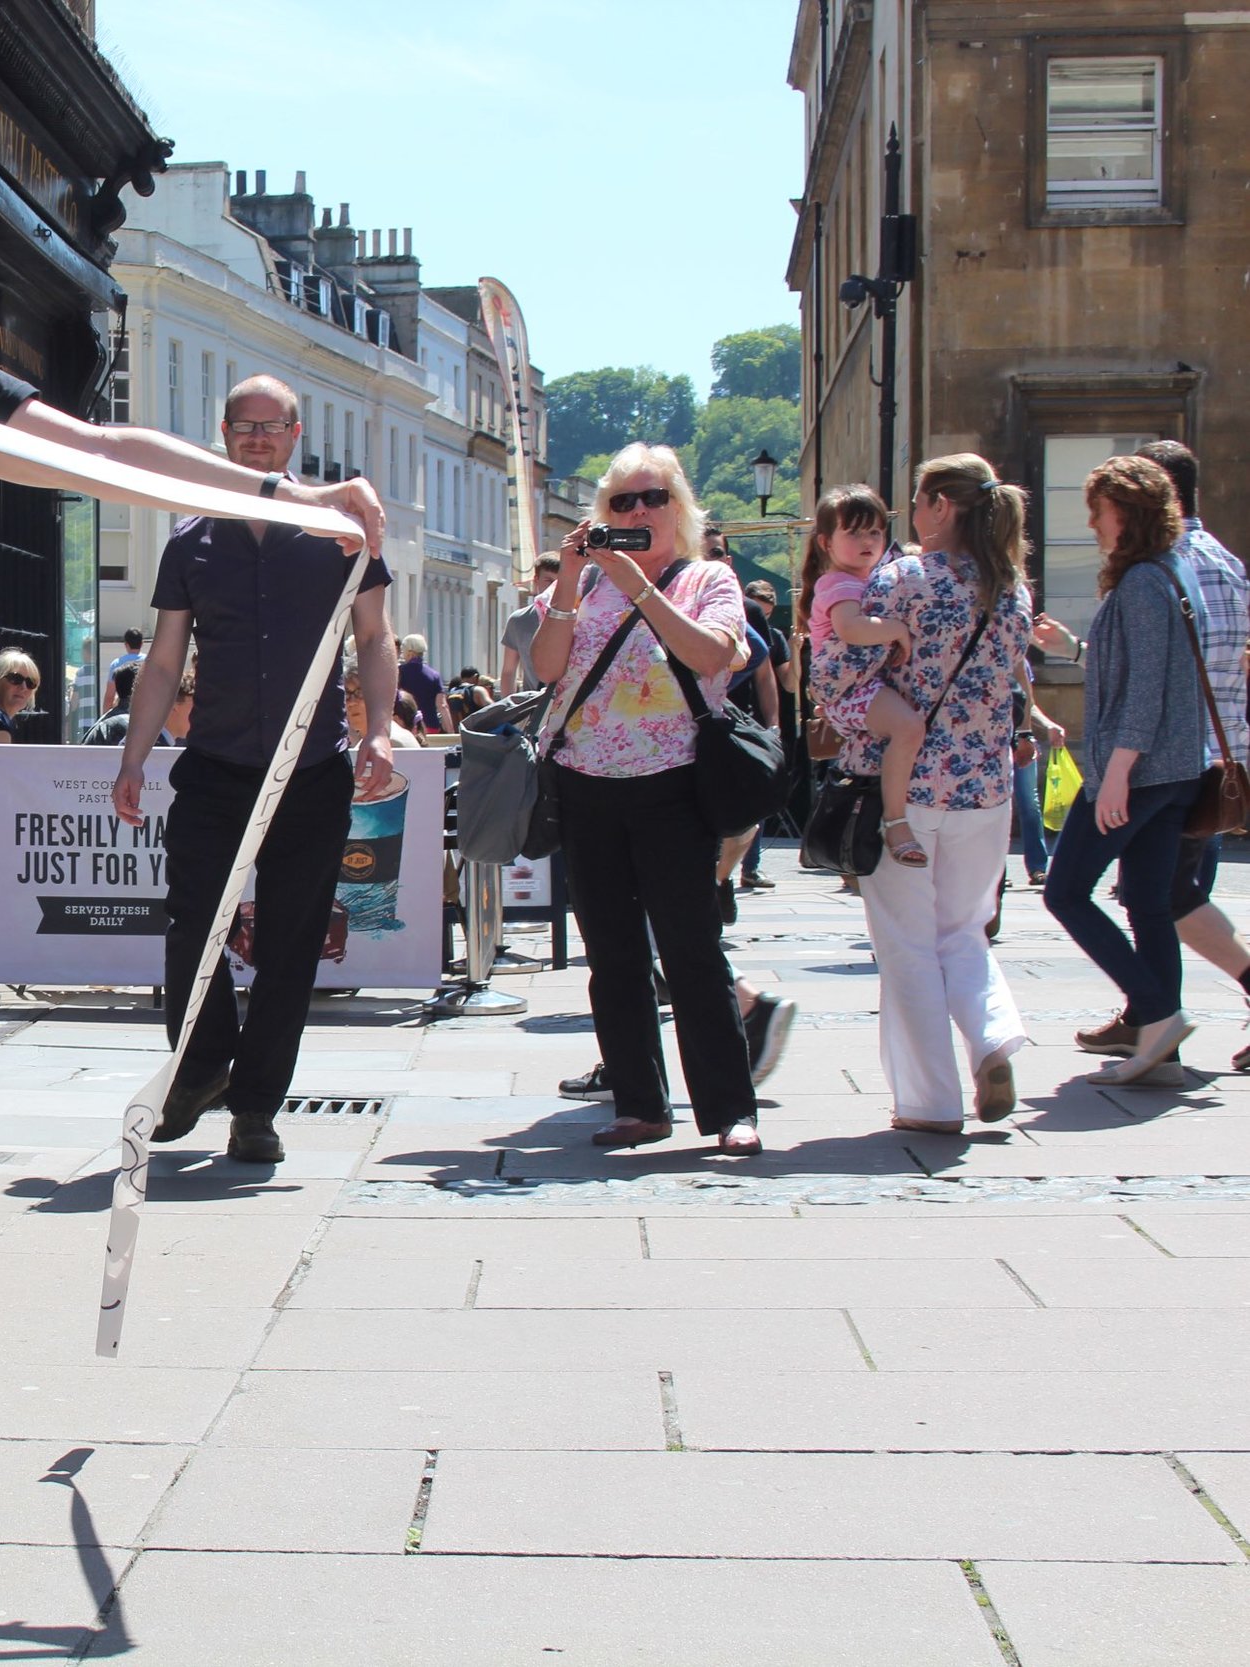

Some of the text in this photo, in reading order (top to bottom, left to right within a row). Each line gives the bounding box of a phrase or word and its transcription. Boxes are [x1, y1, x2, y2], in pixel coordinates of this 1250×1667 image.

[53, 780, 88, 790] WEST
[15, 813, 120, 848] FRESHLY
[17, 852, 81, 885] JUST
[92, 852, 138, 886] FOR
[64, 905, 150, 915] SERVED FRESH
[89, 917, 125, 926] DAILY
